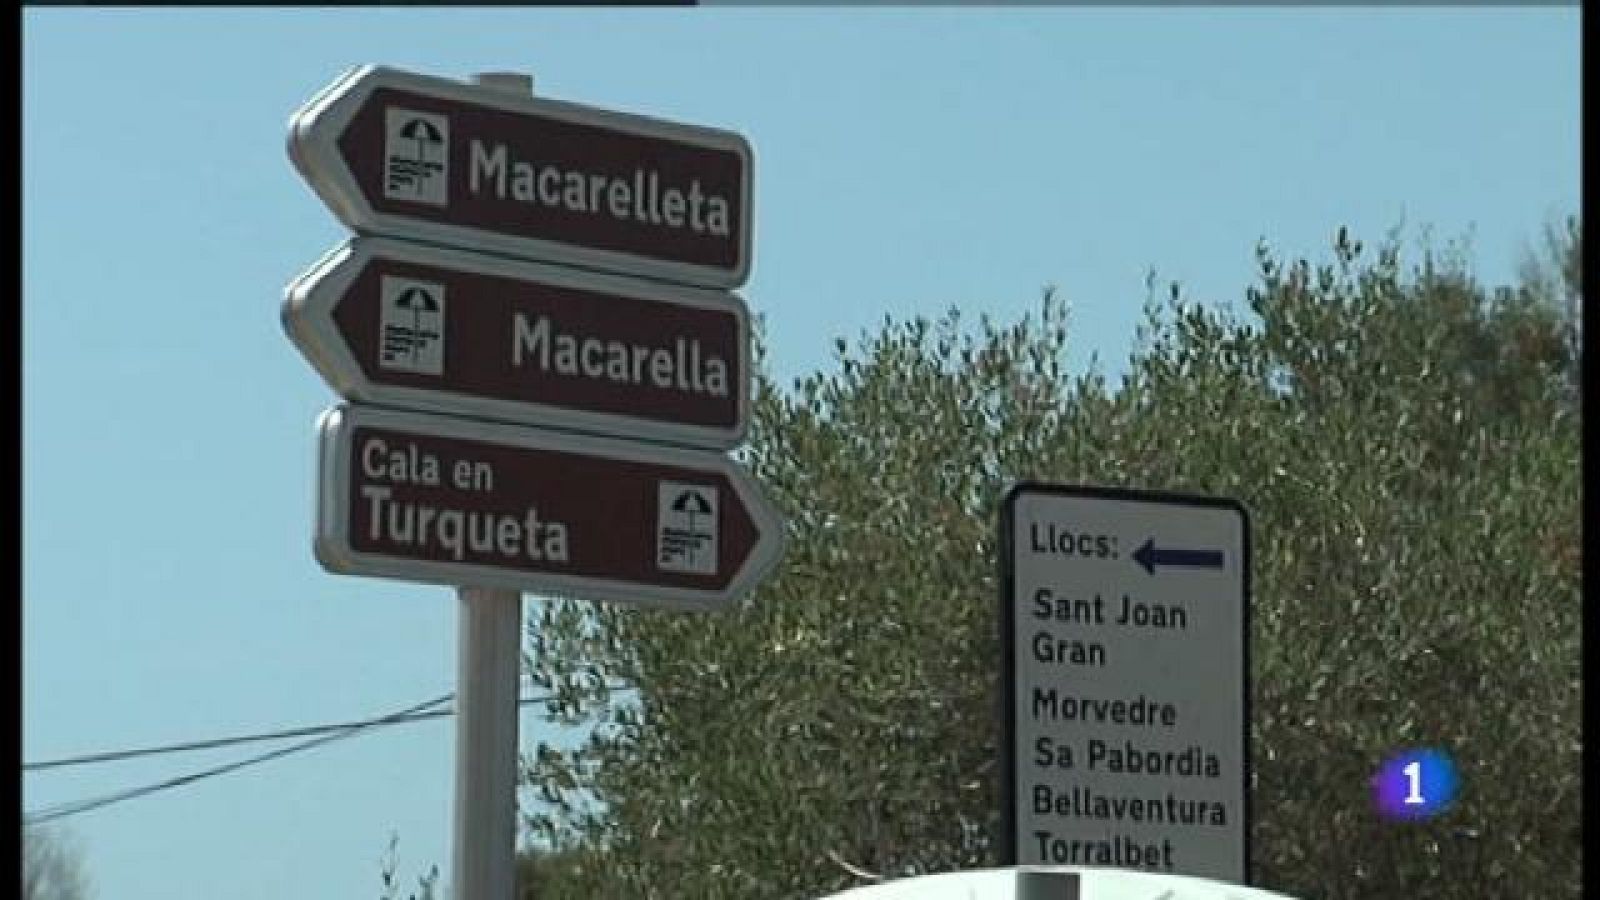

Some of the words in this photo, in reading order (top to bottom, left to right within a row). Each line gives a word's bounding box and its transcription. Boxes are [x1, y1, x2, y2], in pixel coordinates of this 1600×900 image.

[468, 139, 730, 236] Macarelleta
[511, 312, 729, 396] Macarella
[362, 439, 440, 486] Cala
[453, 459, 493, 491] en
[360, 485, 570, 562] Turqueta
[1030, 522, 1119, 560] Llocs:
[1032, 588, 1103, 625] Sant
[1116, 595, 1187, 630] Joan
[1032, 632, 1106, 666] Gran
[1032, 687, 1177, 727] Morvedre
[1034, 737, 1074, 769] Sa
[1033, 784, 1227, 826] Bellaventura
[1033, 830, 1174, 868] Torralbet
